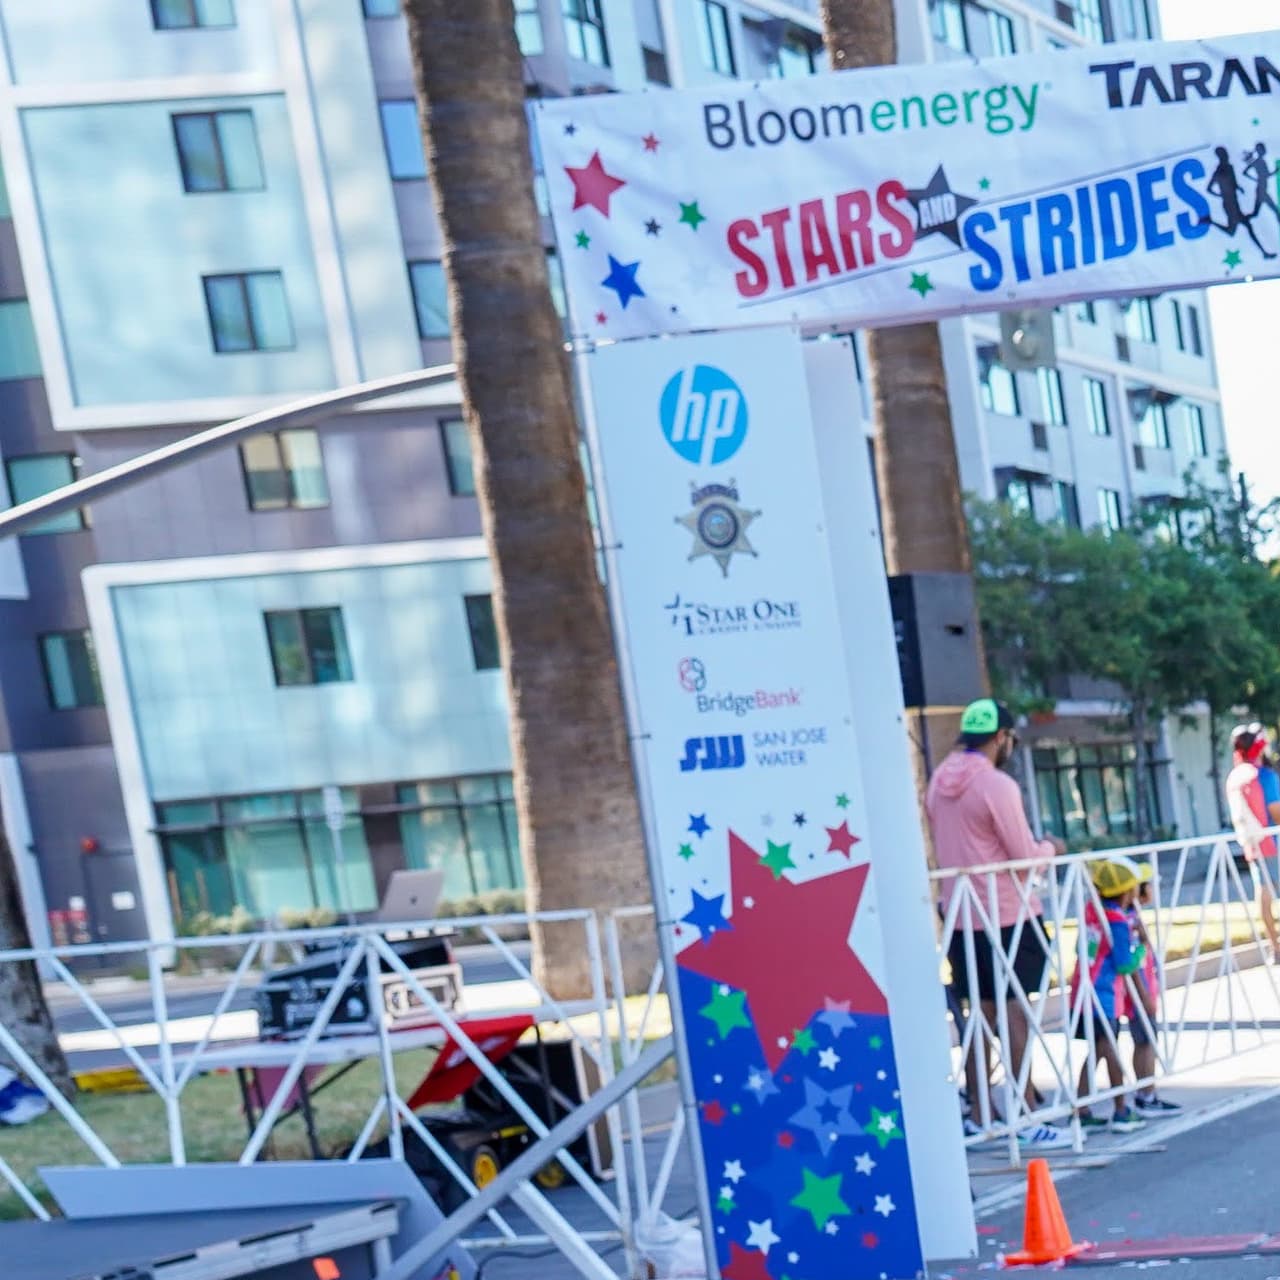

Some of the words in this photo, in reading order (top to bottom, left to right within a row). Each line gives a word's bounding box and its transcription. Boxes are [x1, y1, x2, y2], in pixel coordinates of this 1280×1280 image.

[703, 82, 1041, 150] Bloomenergy
[726, 180, 915, 298] STARS
[918, 193, 957, 229] AND
[963, 158, 1210, 291] STRIDES
[671, 364, 742, 465] hp
[696, 687, 799, 717] BridgeBank
[753, 730, 786, 748] SAN
[791, 726, 827, 746] JOSE
[756, 749, 807, 767] WATER
